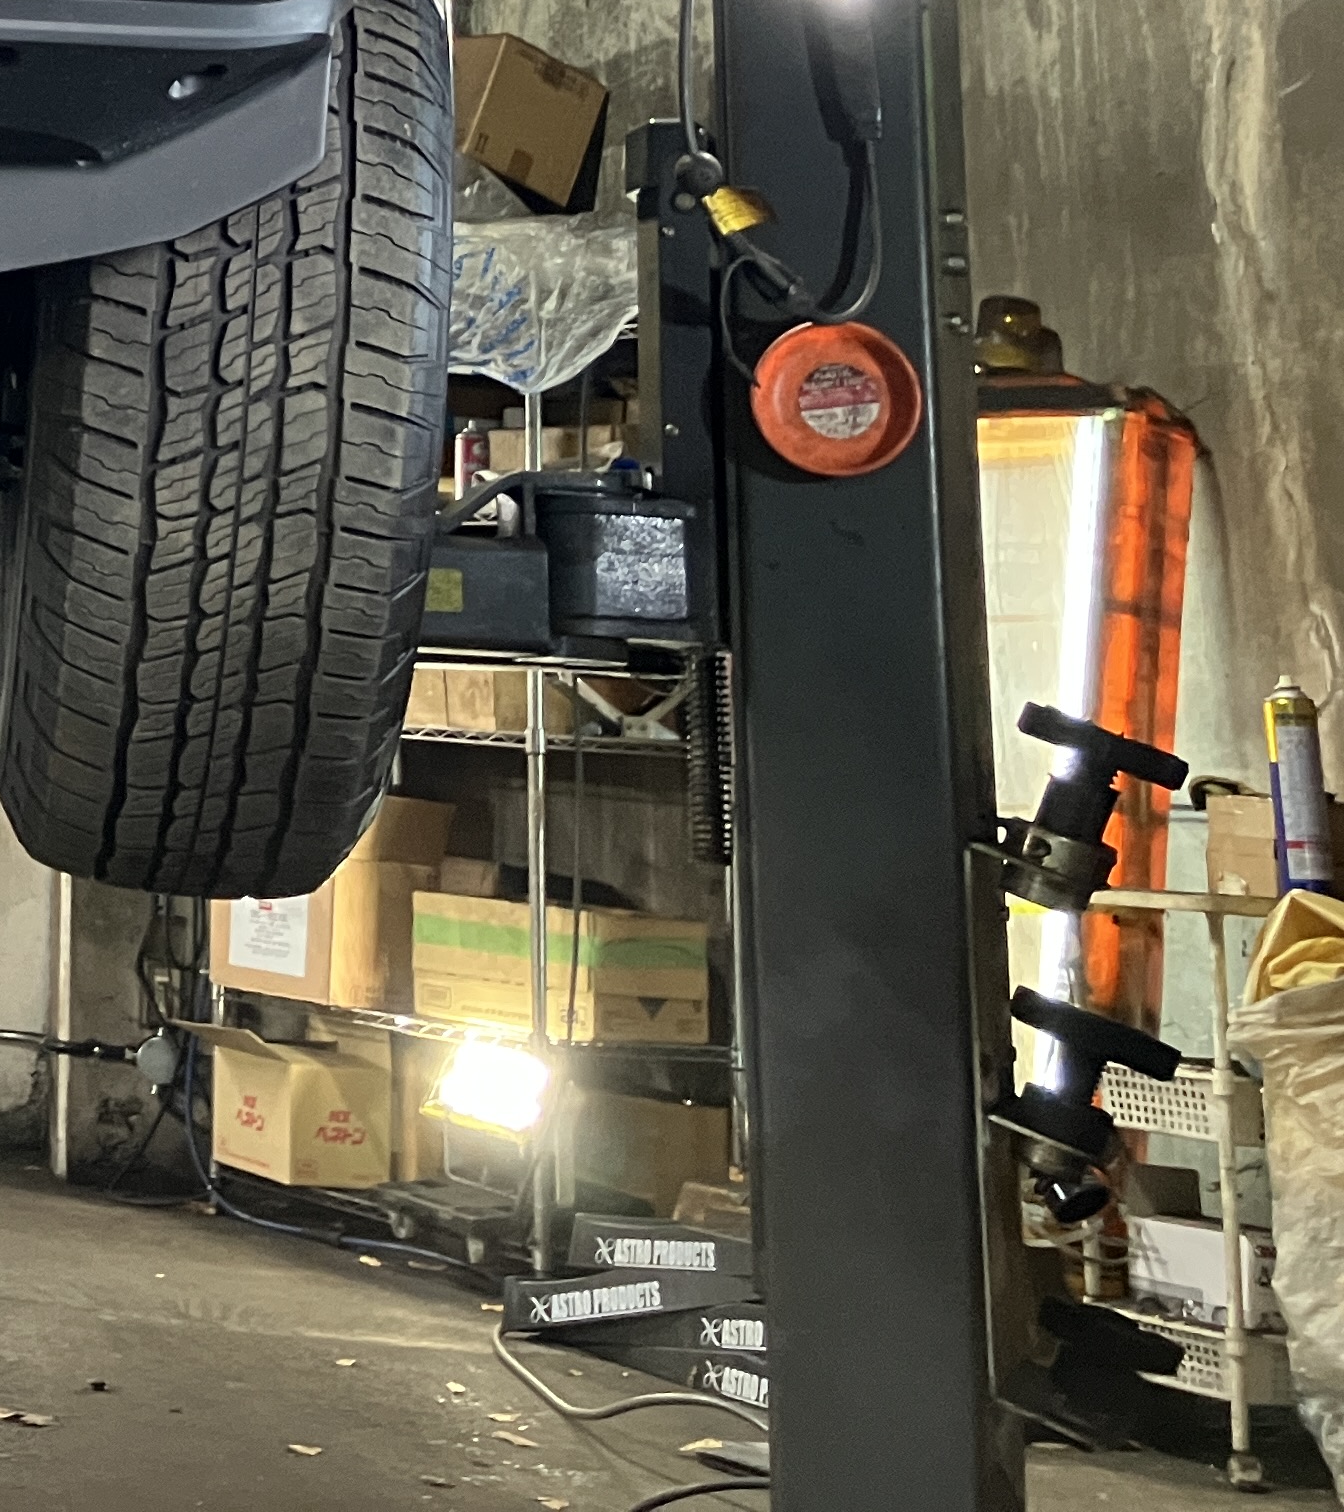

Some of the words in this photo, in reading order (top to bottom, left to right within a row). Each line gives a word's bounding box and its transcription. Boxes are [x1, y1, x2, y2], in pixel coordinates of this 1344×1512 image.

[614, 1238, 652, 1265] ASTRO
[653, 1240, 716, 1268] PRODUCTS
[551, 1289, 592, 1320] ASTRO
[592, 1281, 661, 1315] PRODUCTS
[721, 1318, 764, 1348] ASTRO
[721, 1366, 759, 1401] ASTRO
